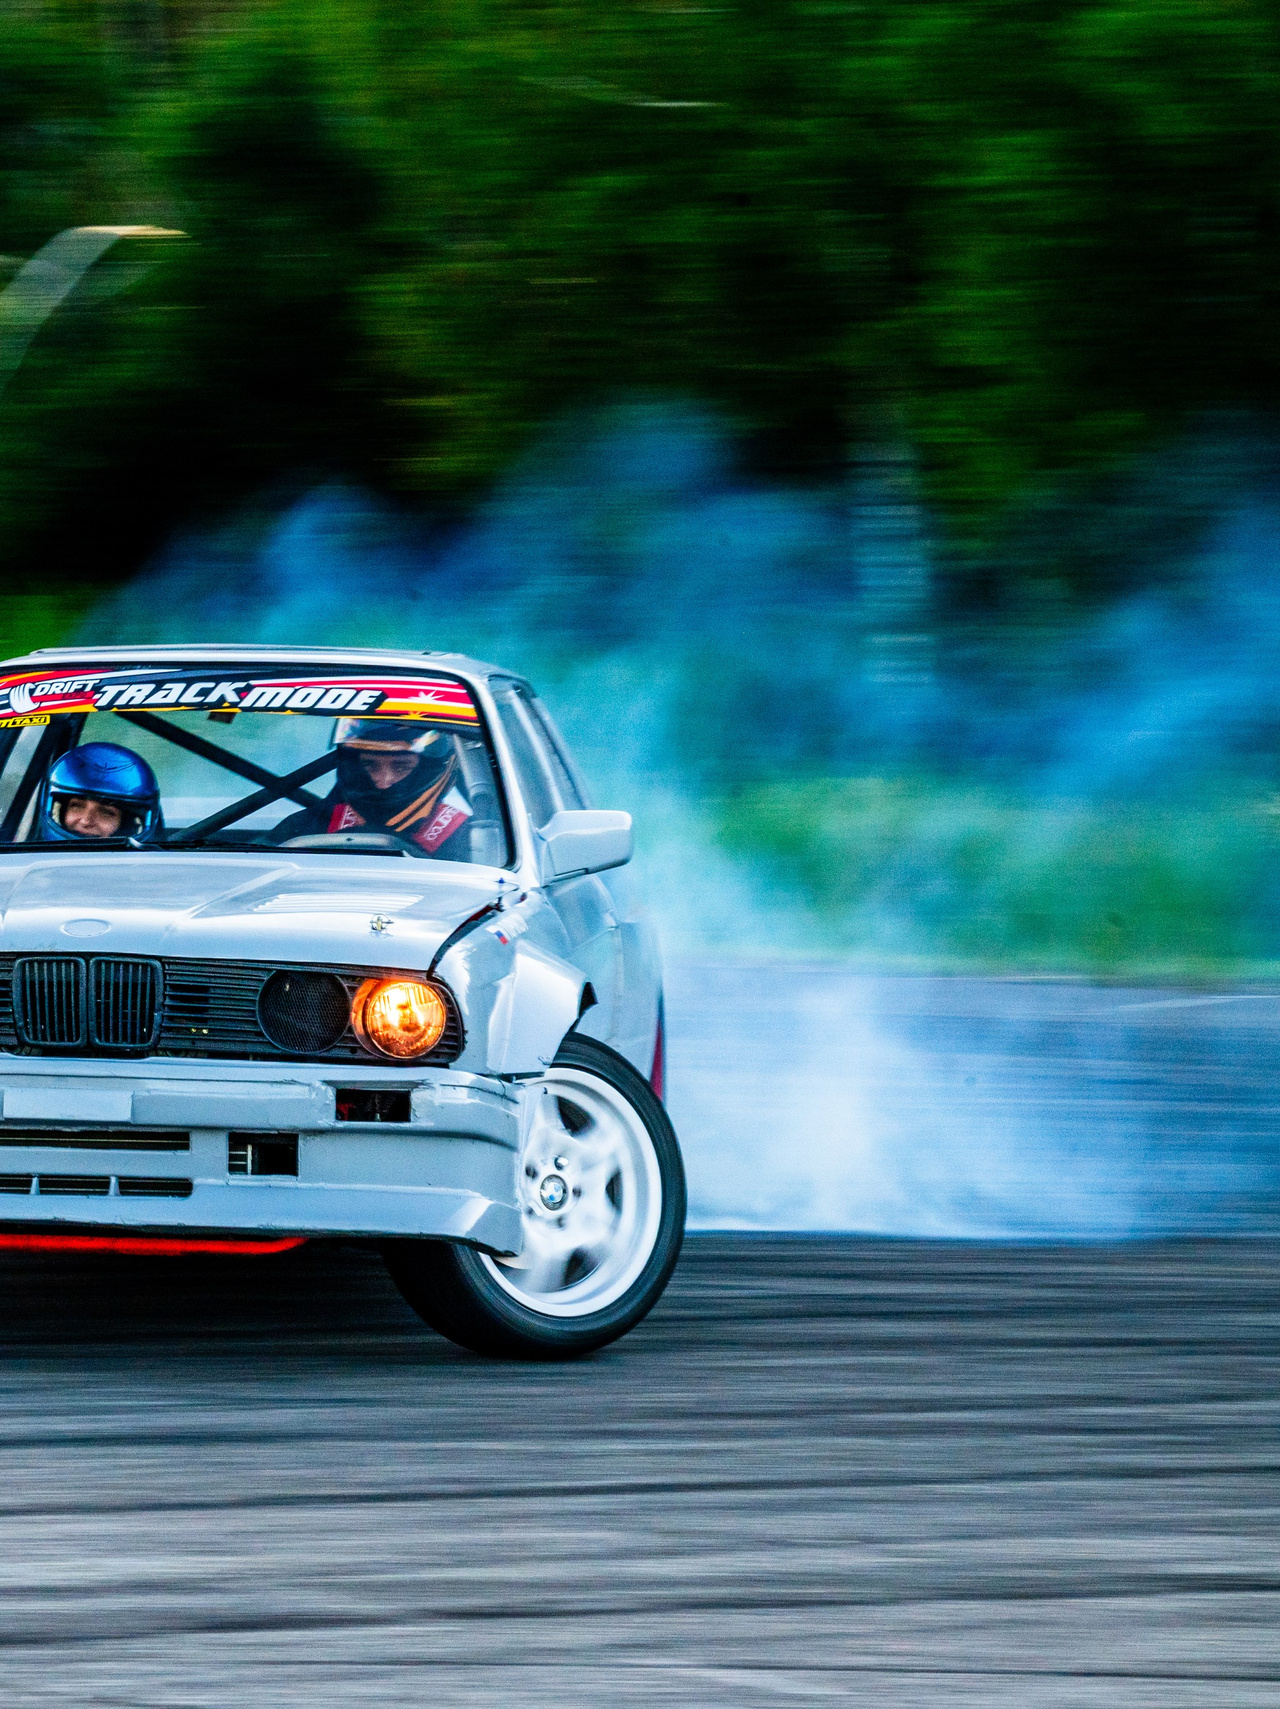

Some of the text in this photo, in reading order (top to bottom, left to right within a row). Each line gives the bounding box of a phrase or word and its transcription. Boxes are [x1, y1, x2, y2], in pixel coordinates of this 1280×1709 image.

[32, 680, 100, 696] DRIFT
[94, 682, 382, 710] TRACK MODE
[13, 716, 46, 725] TAXI
